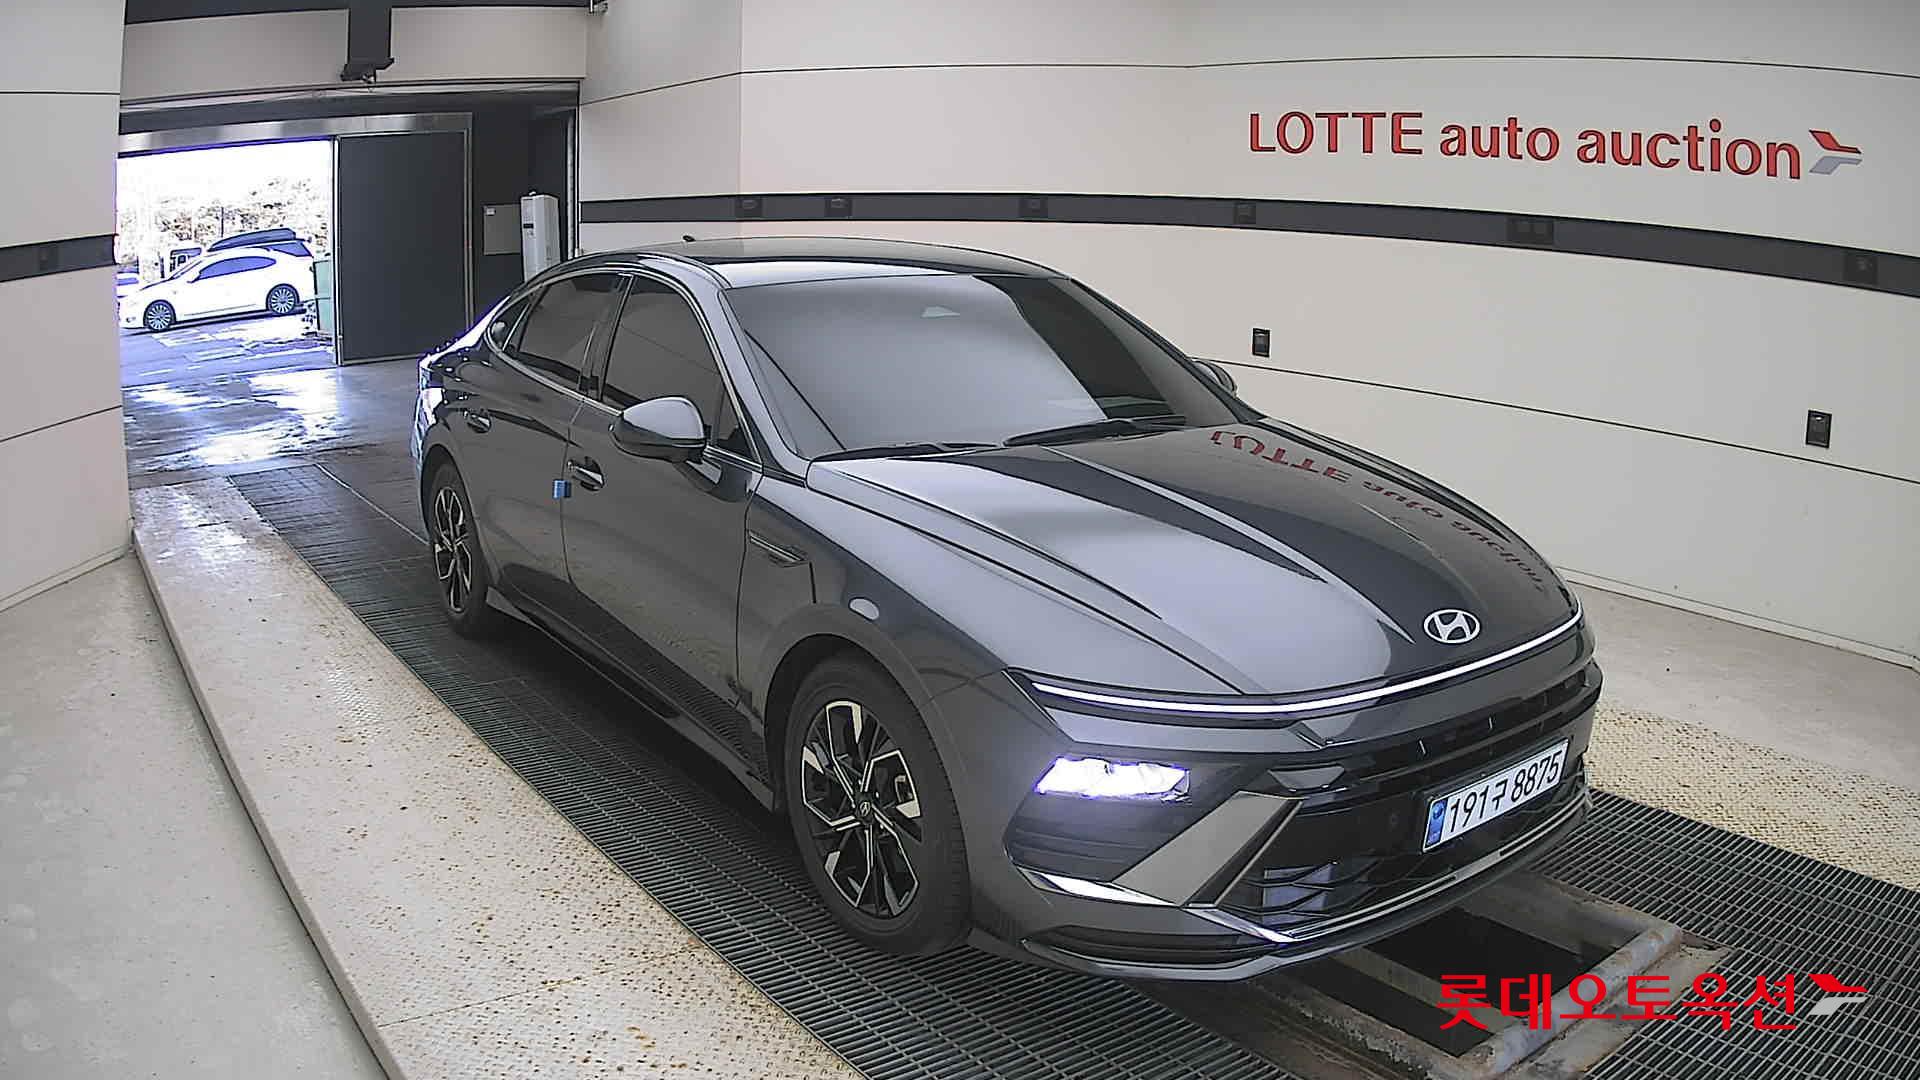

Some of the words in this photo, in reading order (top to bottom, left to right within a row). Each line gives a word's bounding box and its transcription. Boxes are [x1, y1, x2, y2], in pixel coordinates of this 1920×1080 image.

[1250, 112, 1424, 155] LOTTE
[1440, 117, 1561, 161] auto
[1575, 118, 1802, 180] auction
